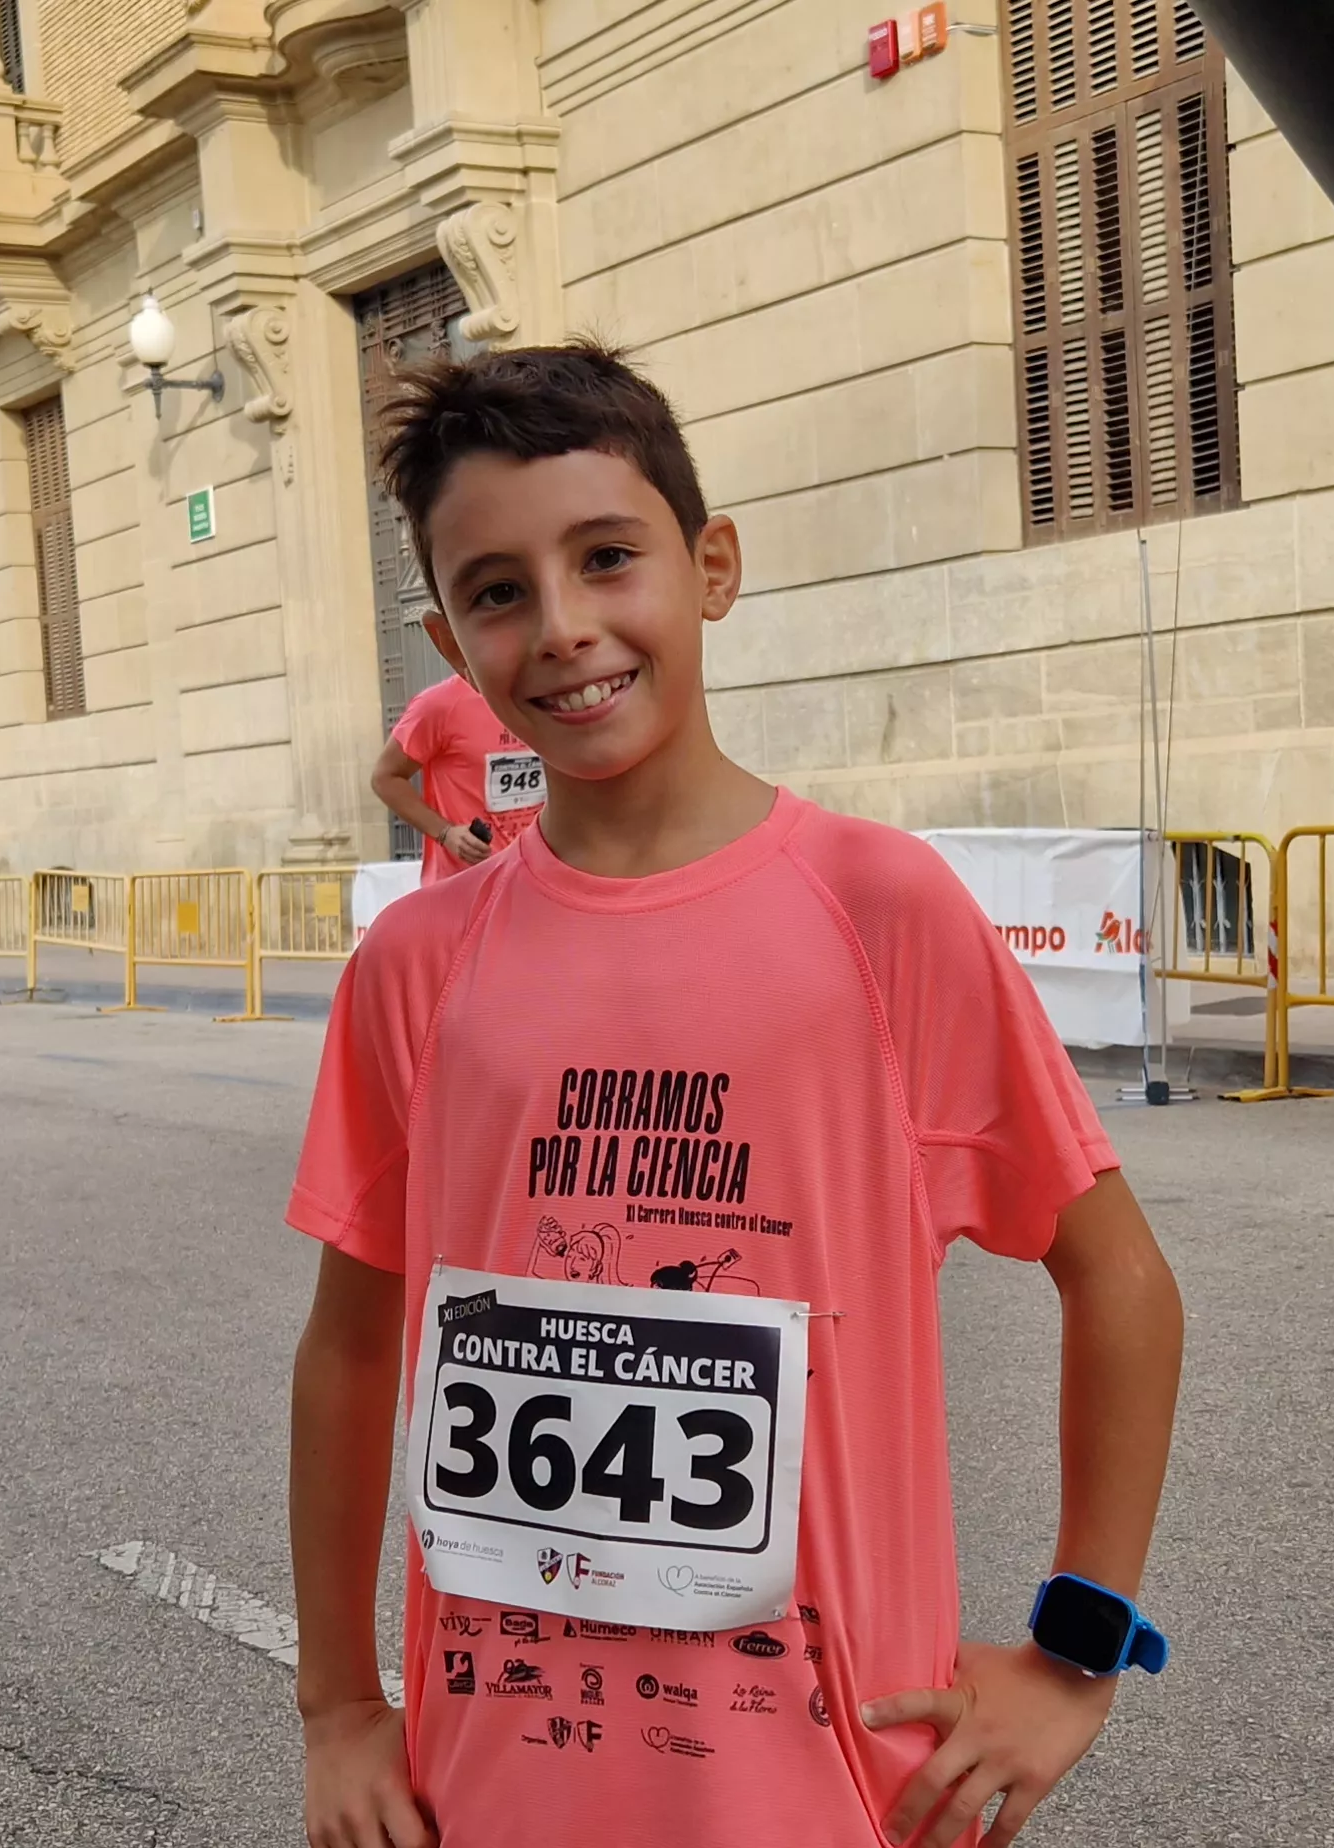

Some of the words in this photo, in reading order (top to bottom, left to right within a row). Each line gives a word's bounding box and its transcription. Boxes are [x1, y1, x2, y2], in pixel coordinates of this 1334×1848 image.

[499, 769, 542, 793] 948
[557, 1067, 730, 1134] CORRAMOS
[528, 1135, 581, 1198] POR
[585, 1135, 620, 1197] LA
[627, 1136, 751, 1204] CIENCIA
[637, 1204, 676, 1225] Carrera
[678, 1207, 712, 1228] Huesca
[714, 1212, 746, 1231] contra
[748, 1213, 758, 1232] el
[443, 1307, 453, 1323] XI
[454, 1296, 491, 1320] EDICIÓN
[540, 1317, 634, 1346] HUESCA
[452, 1332, 562, 1374] CONTRA
[570, 1349, 605, 1378] EL
[614, 1347, 757, 1390] CÁNCER
[436, 1381, 755, 1531] 3643
[436, 1536, 459, 1550] hoya
[460, 1541, 472, 1551] de
[472, 1543, 504, 1558] huesca
[580, 1620, 637, 1636] Humeco
[650, 1627, 715, 1643] URBAN
[738, 1638, 783, 1654] Ferrer
[485, 1682, 553, 1701] VILLAMAYOR
[662, 1683, 698, 1701] walqa
